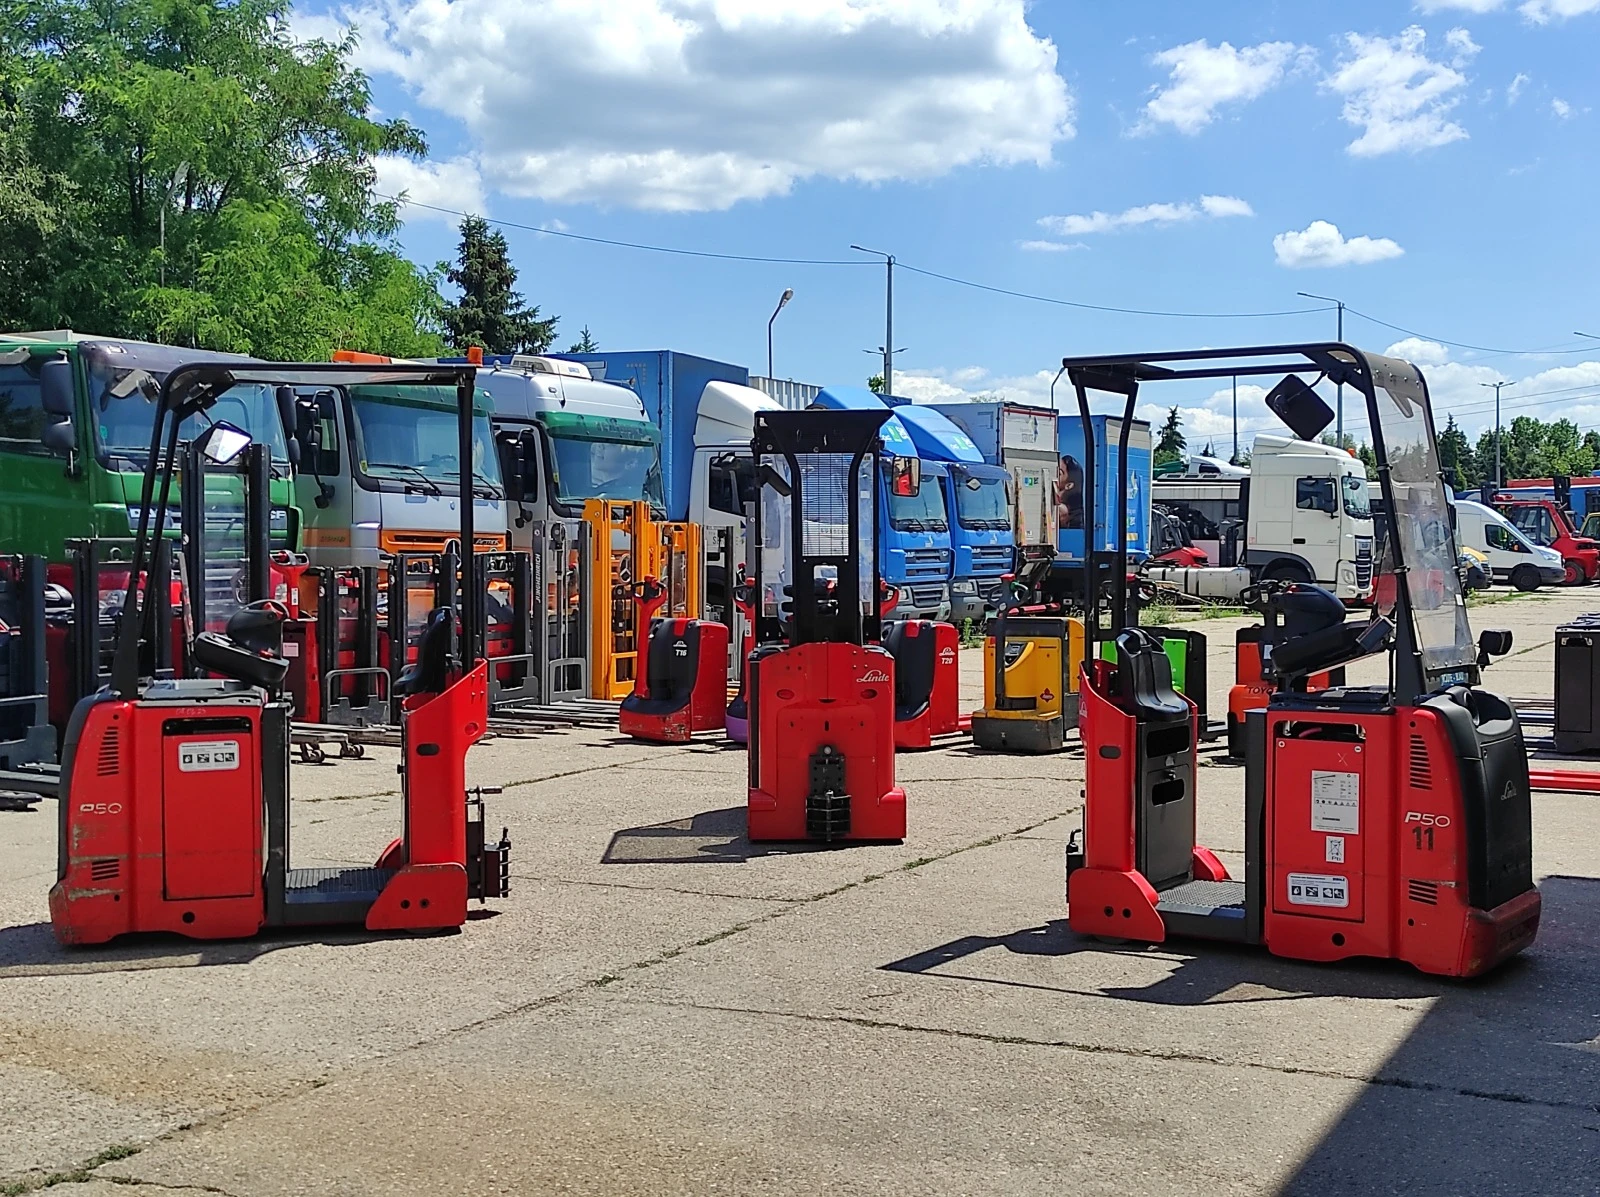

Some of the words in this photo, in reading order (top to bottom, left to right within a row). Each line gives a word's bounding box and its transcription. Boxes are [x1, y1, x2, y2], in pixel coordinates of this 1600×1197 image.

[534, 553, 542, 604] JUNGHEINRICH
[856, 669, 890, 683] Linde
[1247, 686, 1274, 695] TOYO
[80, 802, 122, 815] P50
[1404, 811, 1452, 828] P50
[1412, 826, 1434, 851] 11
